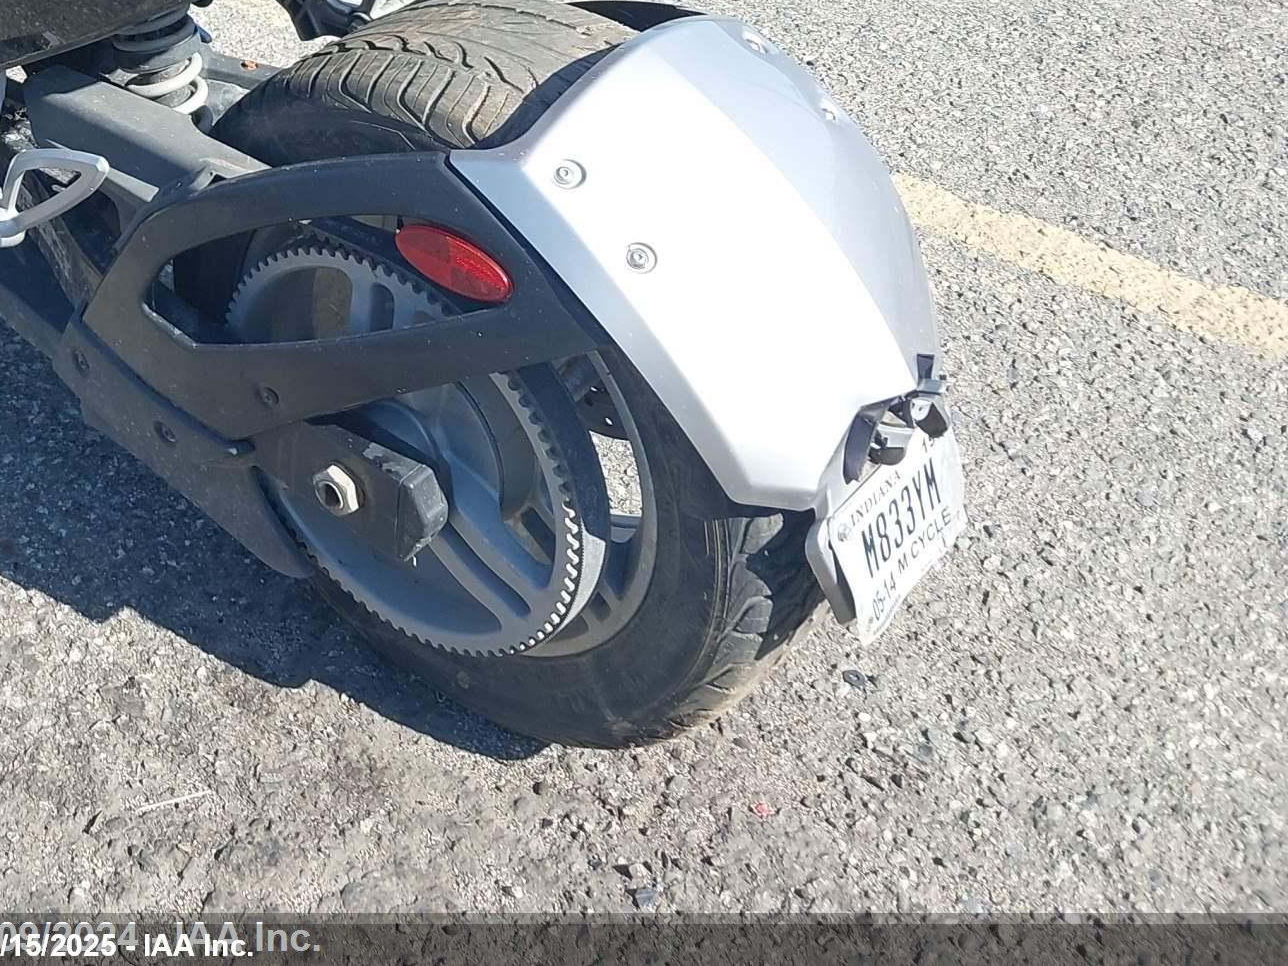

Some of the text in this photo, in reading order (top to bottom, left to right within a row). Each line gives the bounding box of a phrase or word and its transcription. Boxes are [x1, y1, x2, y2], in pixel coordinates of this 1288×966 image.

[850, 469, 902, 527] INDIANA
[861, 457, 942, 579] M833YM
[910, 506, 951, 560] CYCLE
